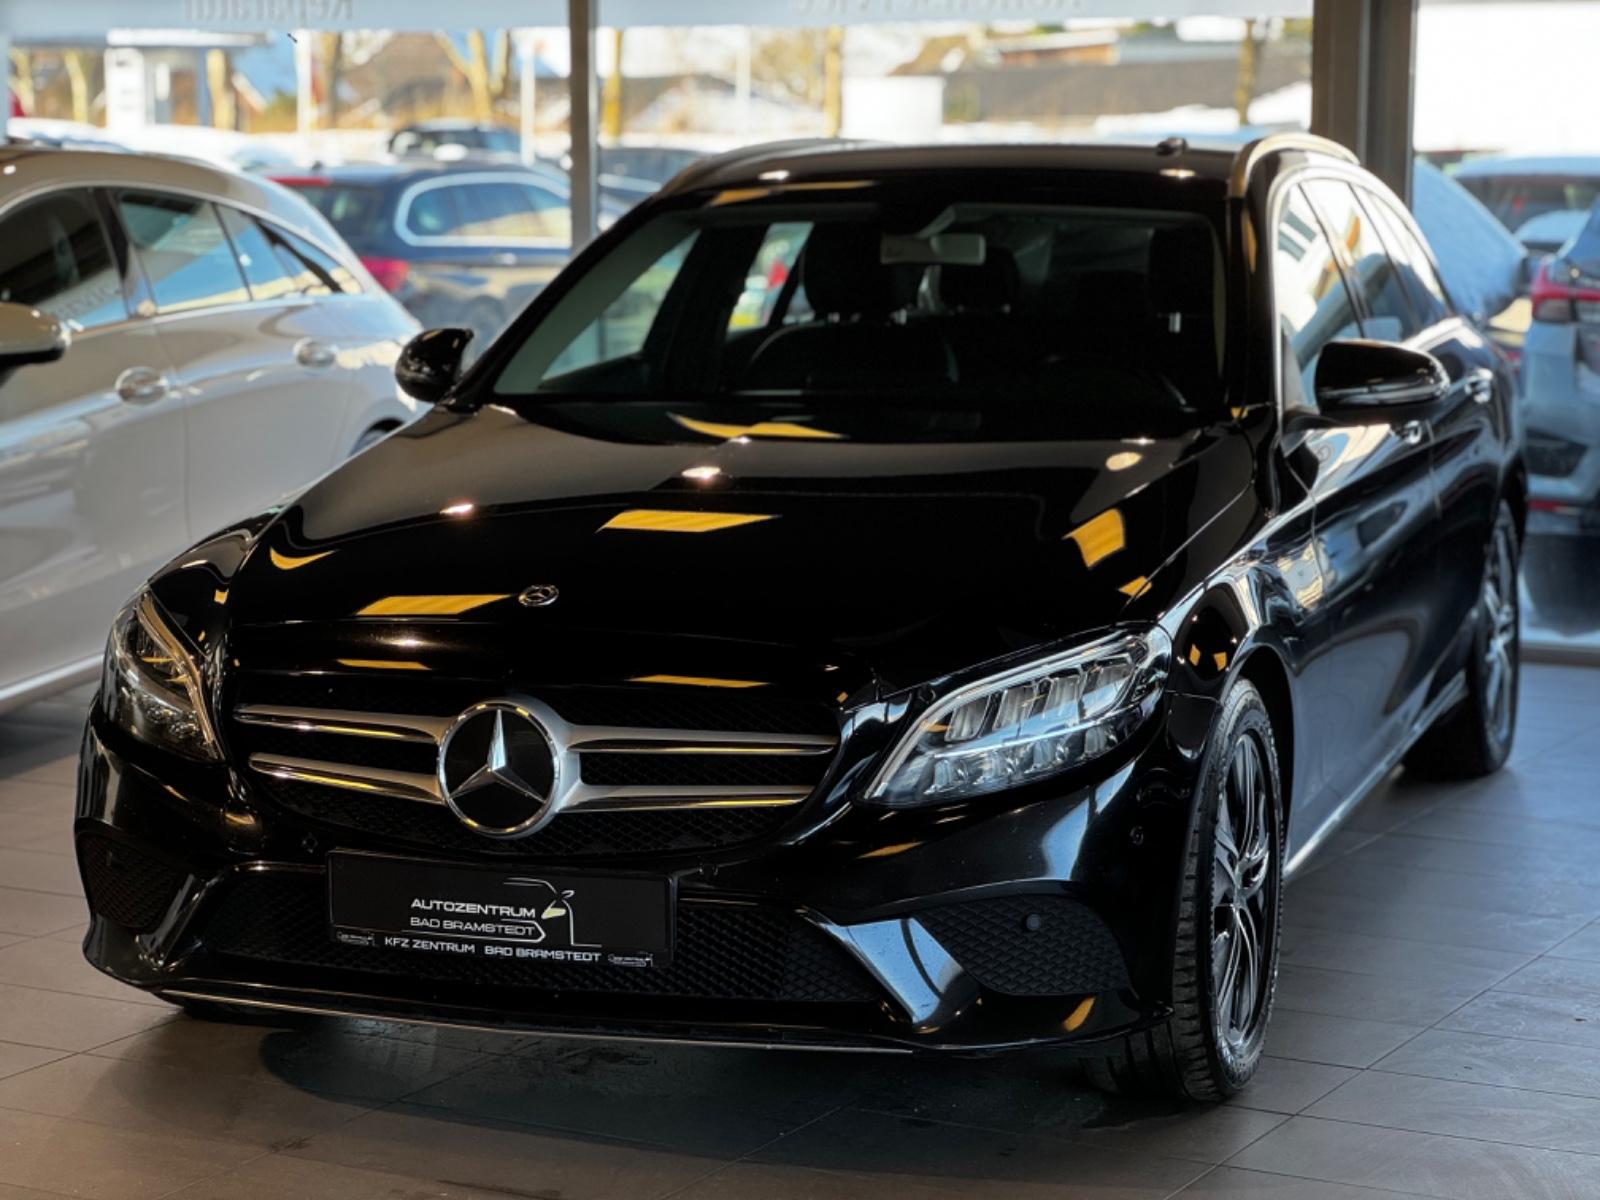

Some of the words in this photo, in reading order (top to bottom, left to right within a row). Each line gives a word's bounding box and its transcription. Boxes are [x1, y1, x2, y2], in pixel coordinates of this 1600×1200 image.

[411, 898, 536, 918] AUTOZENTRUM
[410, 917, 440, 928] BAD
[443, 920, 535, 936] BRAMSTEDT
[384, 936, 409, 949] KFZ
[412, 939, 475, 953] ZENTRUM
[484, 945, 513, 957] BAD
[515, 947, 601, 961] BRAMSTEDT
